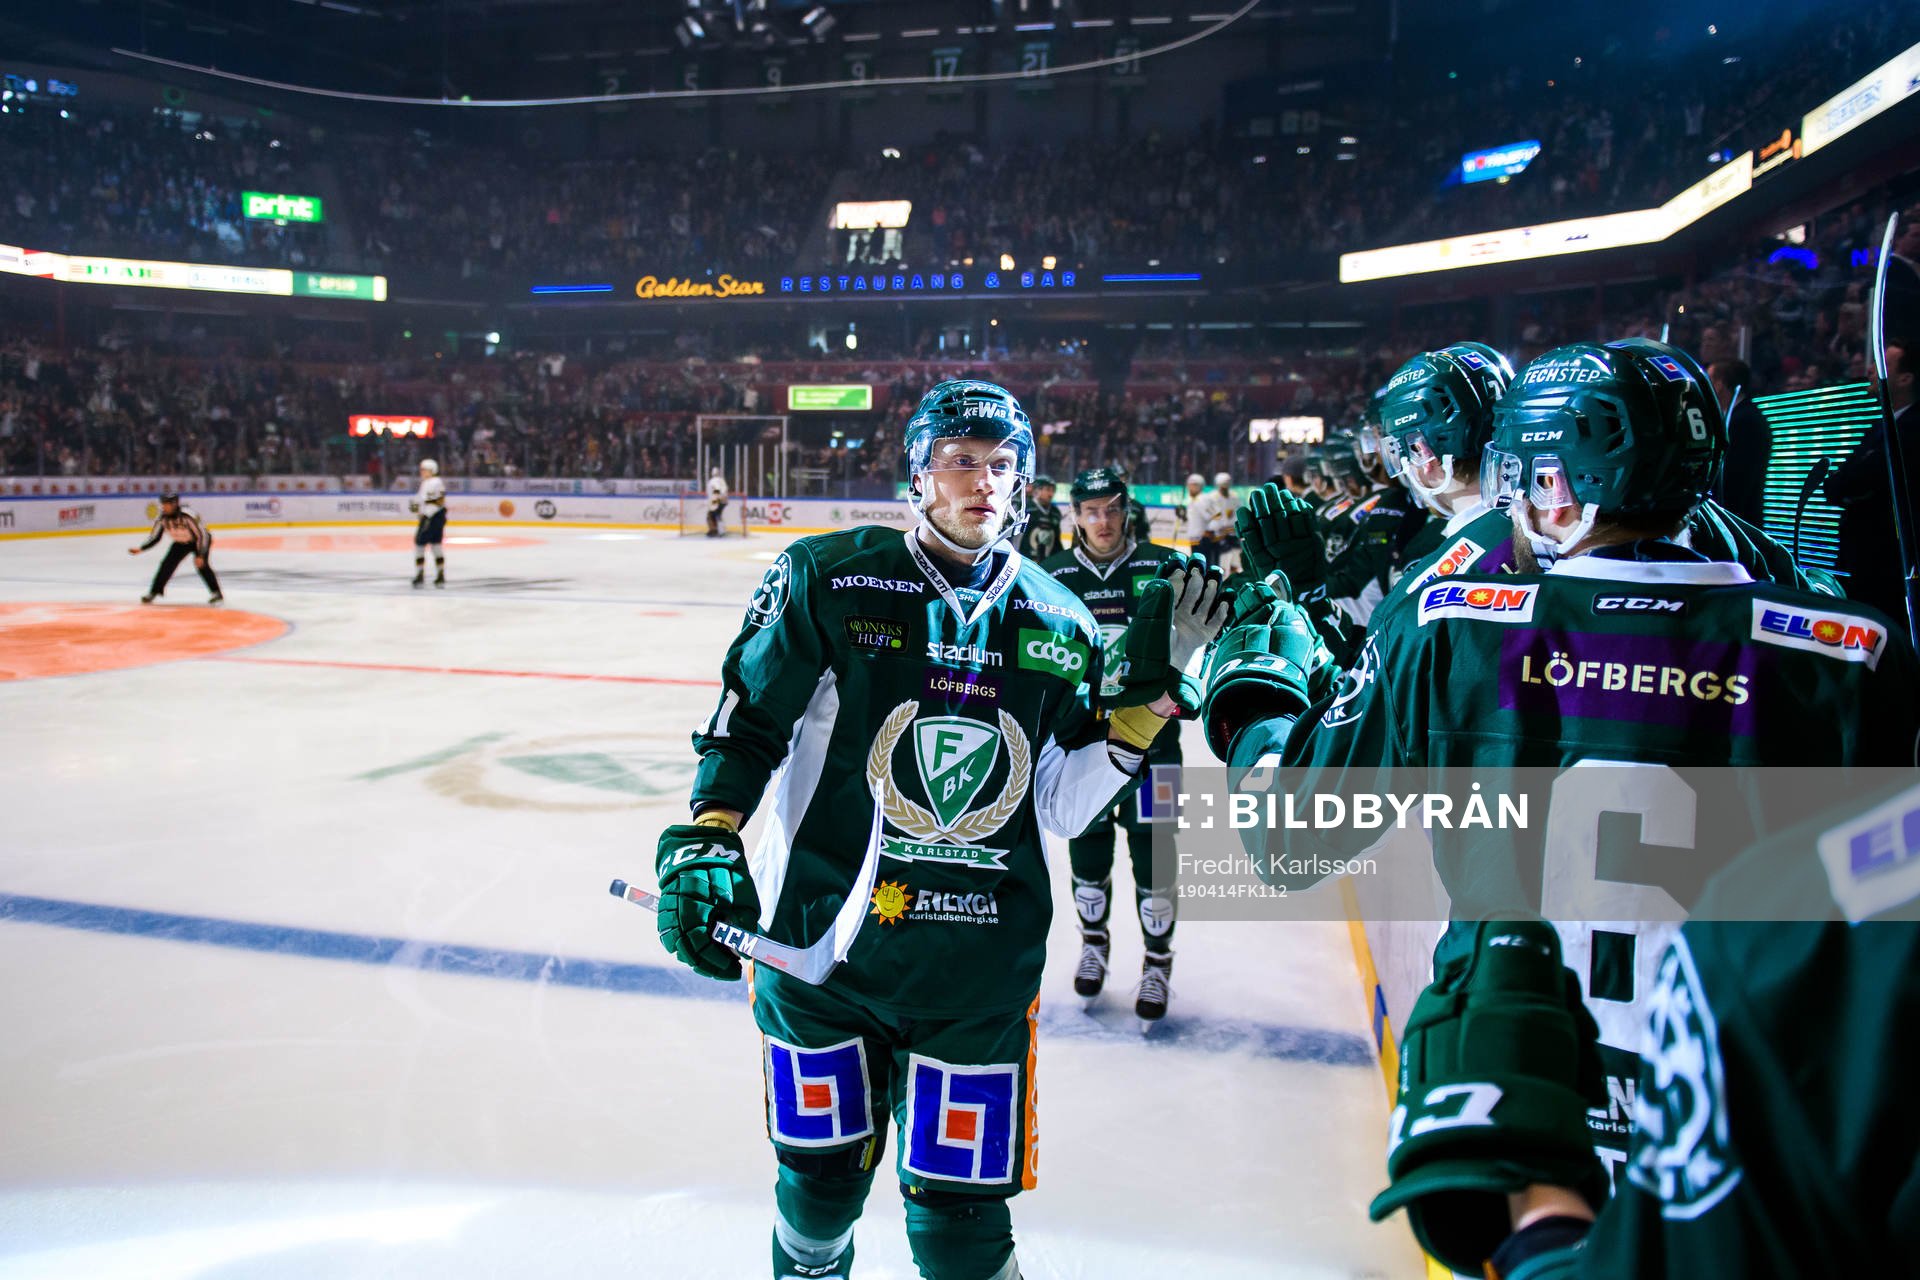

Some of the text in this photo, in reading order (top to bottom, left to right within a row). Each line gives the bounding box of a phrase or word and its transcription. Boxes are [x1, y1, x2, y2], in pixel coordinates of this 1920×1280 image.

[934, 57, 958, 81] 17
[1022, 52, 1049, 77] 21
[250, 194, 314, 219] print
[636, 271, 1076, 298] Golden Star RESTAURANG & BAR
[1522, 367, 1601, 385] TECHSTEP
[1394, 413, 1418, 426] CCM
[1687, 408, 1707, 440] 6
[1521, 430, 1563, 442] CCM
[850, 508, 905, 521] ŠKODA
[912, 550, 950, 594] stadium
[985, 564, 1014, 603] stadium
[959, 593, 976, 603] SHL
[1083, 588, 1126, 601] stadium
[1423, 586, 1531, 613] ELON
[1596, 596, 1685, 612] CCM
[1092, 607, 1125, 615] ÖFBERGS
[1760, 608, 1882, 653] ELON
[925, 640, 1004, 667] stadium
[1026, 640, 1083, 671] coop
[929, 677, 997, 698] LÖFBERGS
[1520, 651, 1751, 706] LÖFBERGS
[933, 729, 964, 772] F
[942, 756, 977, 804] BK
[658, 843, 742, 880] CCM
[904, 843, 980, 859] KARLSTAD
[1540, 759, 1699, 1050] 6
[908, 912, 999, 925] karlstadsenergi.se
[712, 920, 759, 956] CCM
[793, 1259, 840, 1276] CCM
